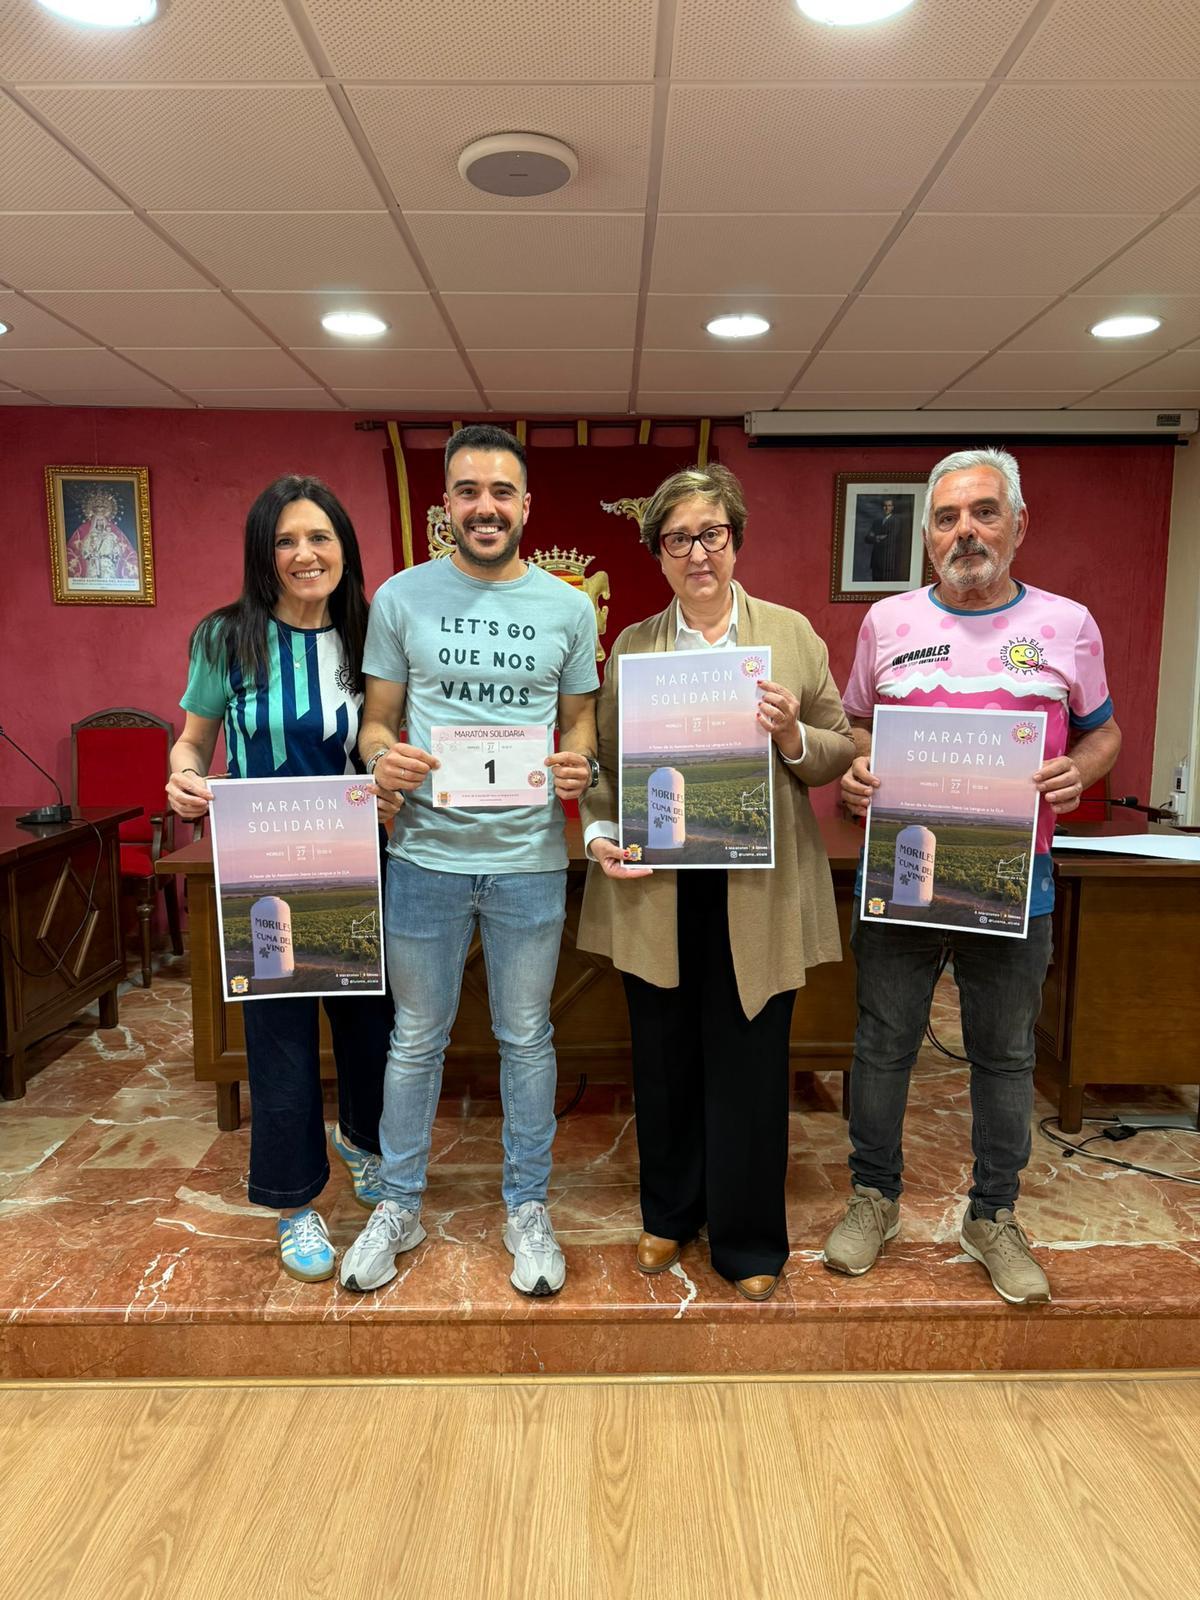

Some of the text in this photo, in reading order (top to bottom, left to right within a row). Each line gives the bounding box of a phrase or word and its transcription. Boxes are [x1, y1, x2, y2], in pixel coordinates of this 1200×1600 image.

[441, 616, 536, 641] LET'S GO
[439, 648, 536, 672] QUE NOS
[999, 645, 1020, 674] LENGUA
[656, 670, 733, 686] MARATÓN
[440, 680, 530, 706] VAMOS
[651, 689, 739, 706] SOLIDARIA
[454, 729, 525, 738] MARATÓN SOLIDARIA
[913, 730, 1002, 746] MARATÓN
[907, 750, 1006, 767] SOLIDARIA
[485, 759, 495, 784] 1
[951, 782, 961, 790] 27
[651, 787, 684, 803] MORILES
[252, 797, 338, 814] MARATÓN
[248, 818, 345, 833] SOLIDARIA
[900, 844, 934, 864] MORILES
[921, 866, 934, 876] DEL
[255, 917, 291, 932] MORILES
